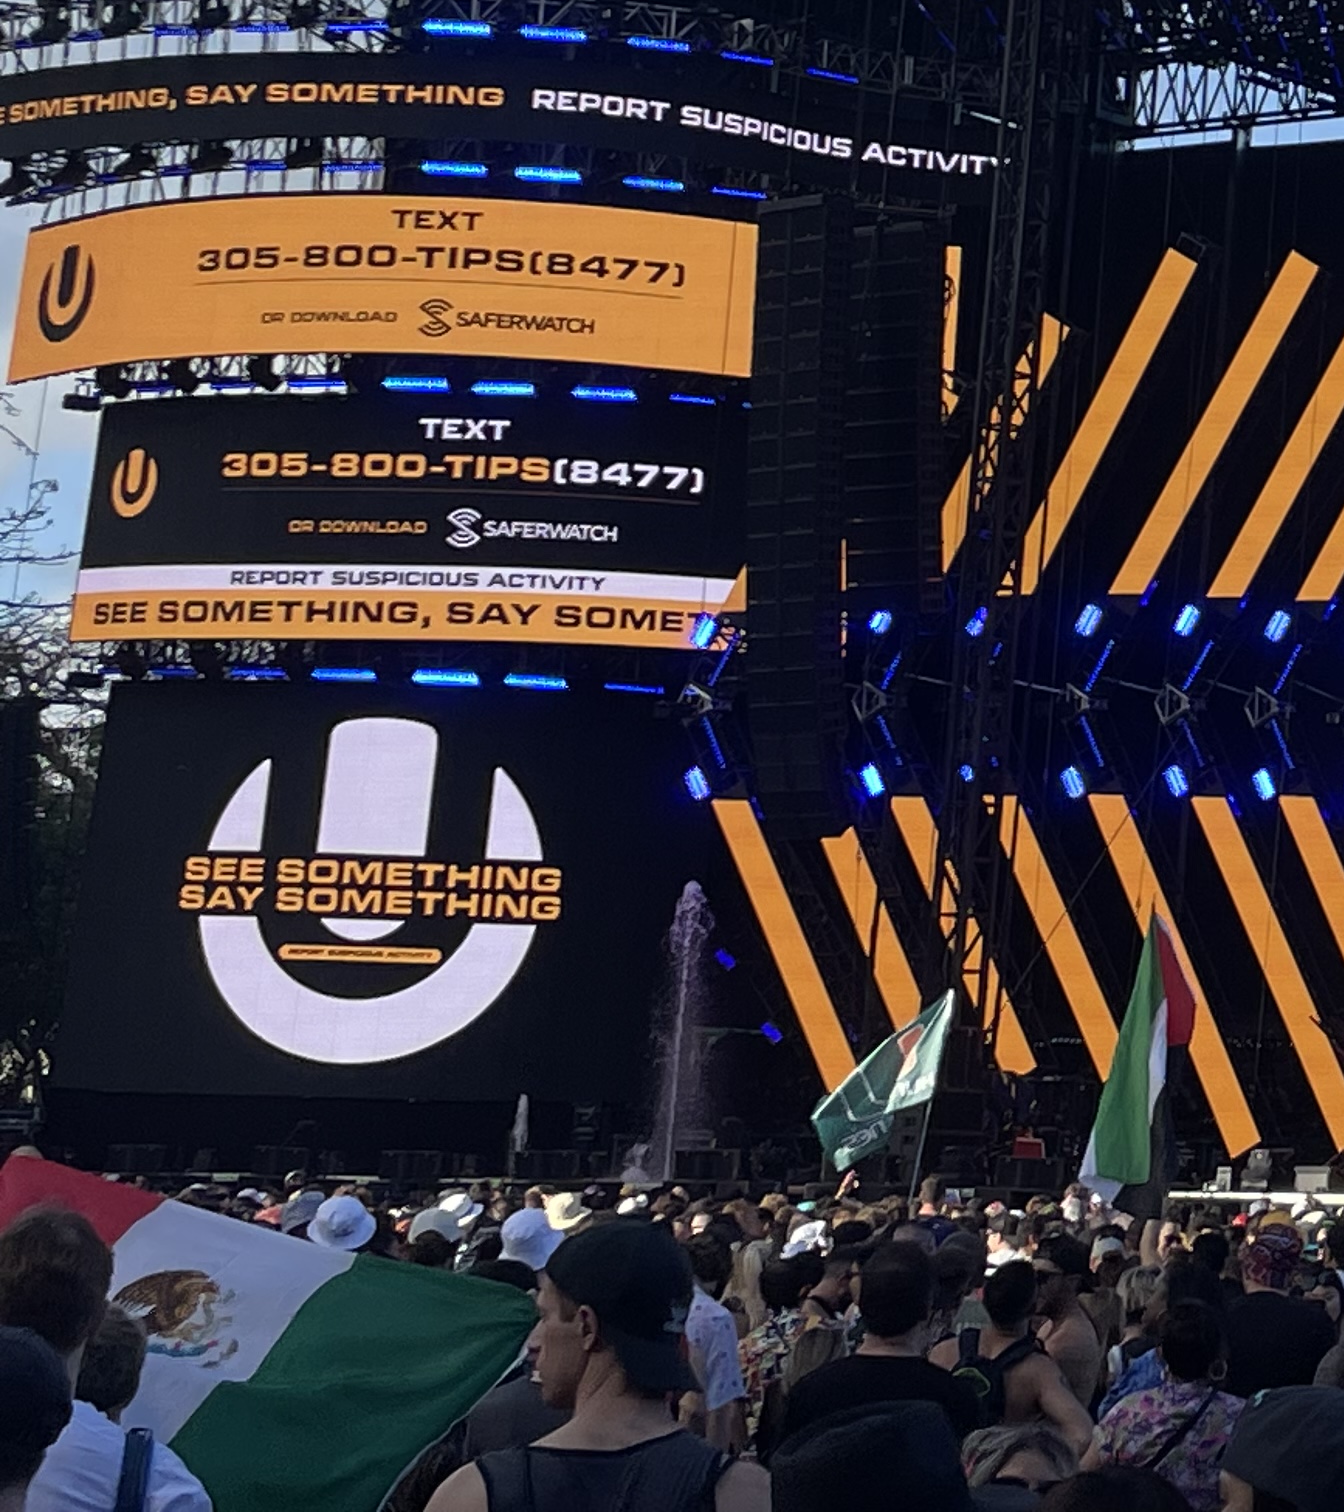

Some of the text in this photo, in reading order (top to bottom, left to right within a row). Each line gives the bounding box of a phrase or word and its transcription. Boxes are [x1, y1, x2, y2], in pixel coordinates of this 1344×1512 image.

[9, 87, 177, 124] SOMETHING,
[185, 83, 260, 106] SAY
[266, 82, 505, 107] SOMETHING
[531, 89, 671, 122] REPORT
[680, 105, 853, 159] SUSPICIOUS
[392, 209, 484, 231] TEXT
[197, 245, 686, 287] 305-800-TIPS(8477)
[261, 310, 398, 324] OR DOWNLOAD
[456, 312, 596, 335] SAFERWATCH
[419, 417, 512, 442] TEXT
[221, 452, 705, 494] 305-800-TIPS(8477)
[287, 518, 428, 535] OR DOWNLOAD
[484, 519, 619, 543] SAFERWATCH
[230, 570, 606, 591] REPORT SUSPICIOUS ACTIVITY
[93, 601, 148, 625] SEE
[157, 600, 431, 629] SOMETHING,
[446, 601, 542, 626] SAY
[184, 855, 562, 892] SEE SOMETHING
[179, 885, 562, 921] SAY SOMETHING
